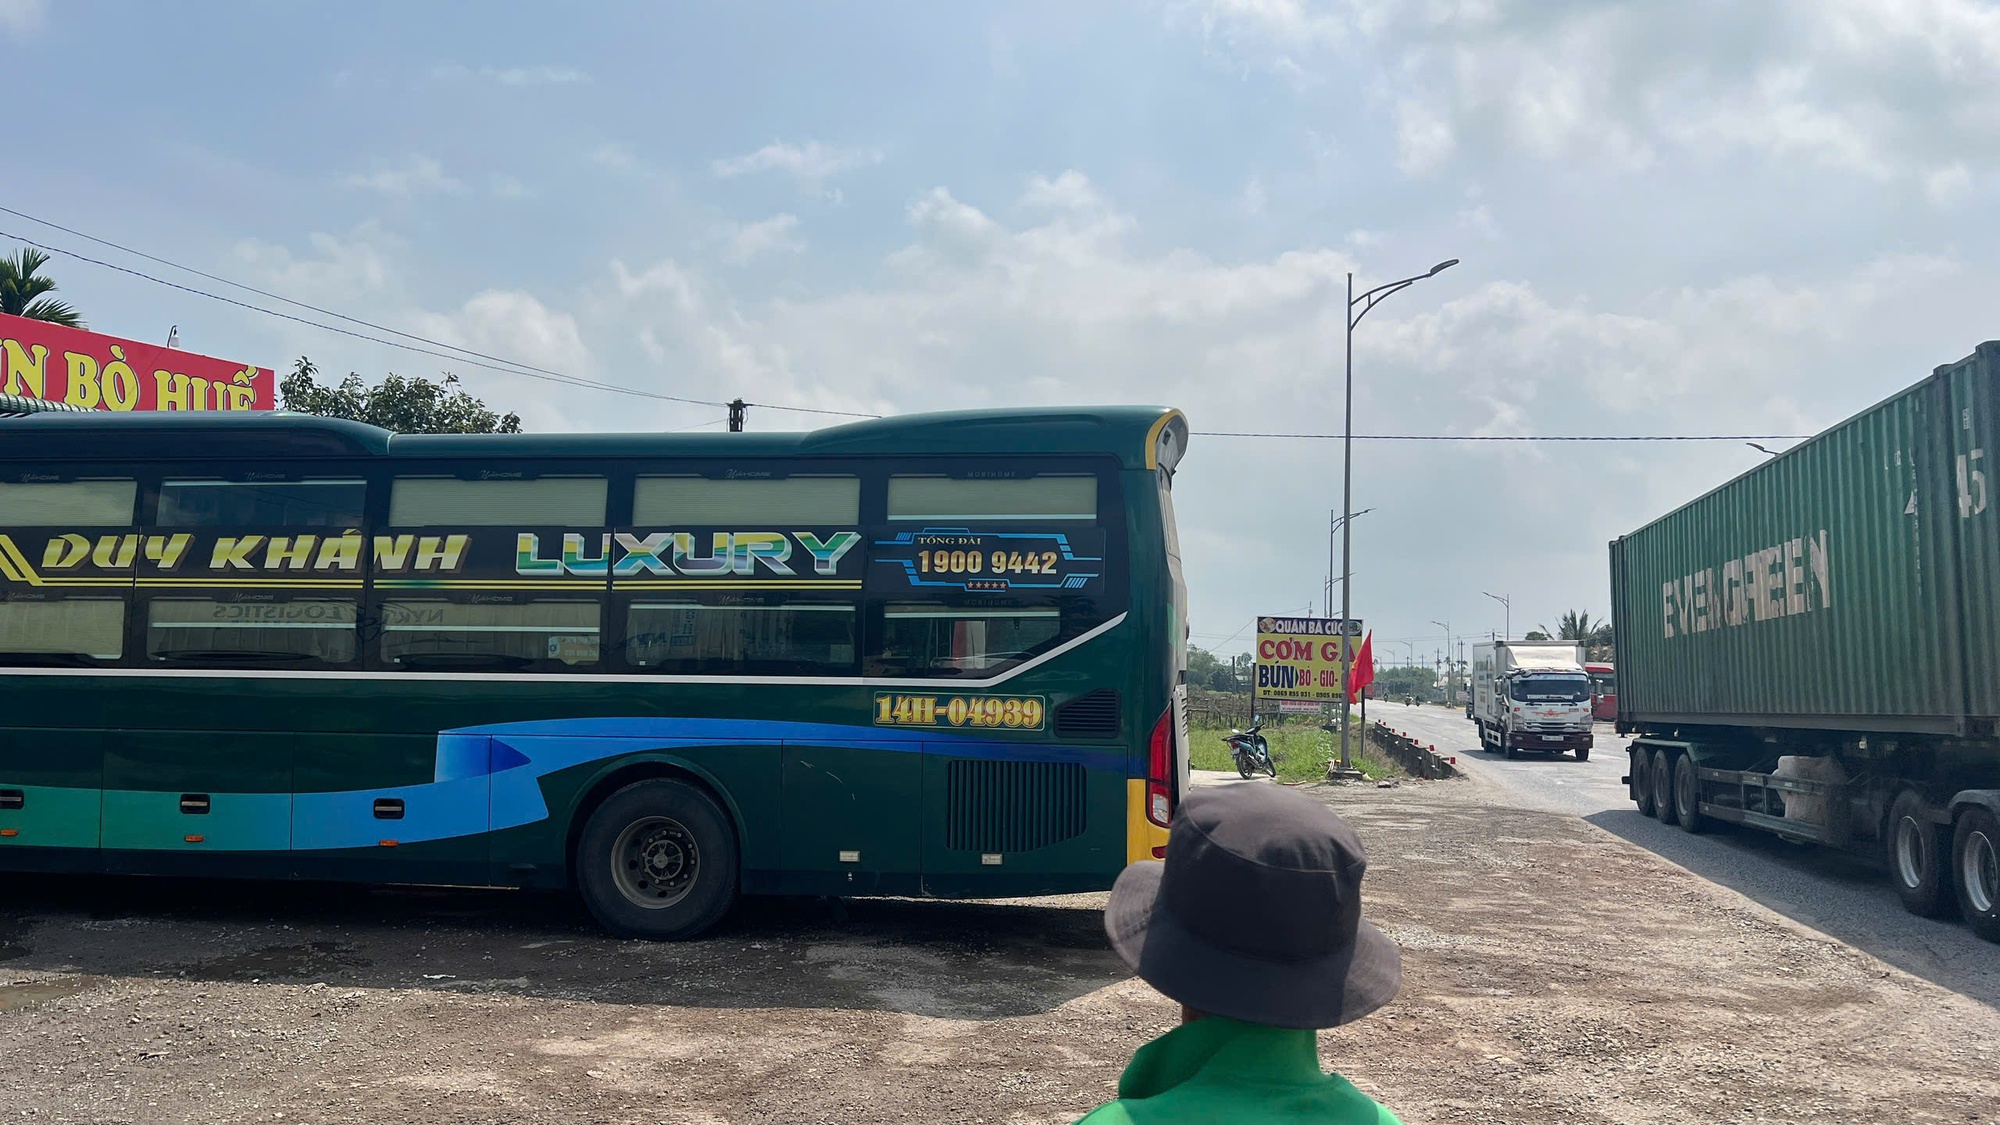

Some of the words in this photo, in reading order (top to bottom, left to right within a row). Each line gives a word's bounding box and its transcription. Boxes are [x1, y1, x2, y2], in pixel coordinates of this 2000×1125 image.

[0, 337, 50, 399] N
[63, 344, 140, 411] BÒ
[153, 365, 258, 411] HUẾ
[41, 533, 195, 572] DUY
[209, 528, 472, 573] KHÁNH
[515, 532, 862, 576] LUXURY
[958, 535, 982, 545] ĐÀI
[918, 550, 982, 574] 1900
[991, 551, 1058, 575] 9442
[1276, 619, 1306, 634] QUÁN
[1259, 637, 1313, 661] CƠM
[1258, 660, 1294, 688] BÚN
[875, 695, 1043, 728] 14H-04939
